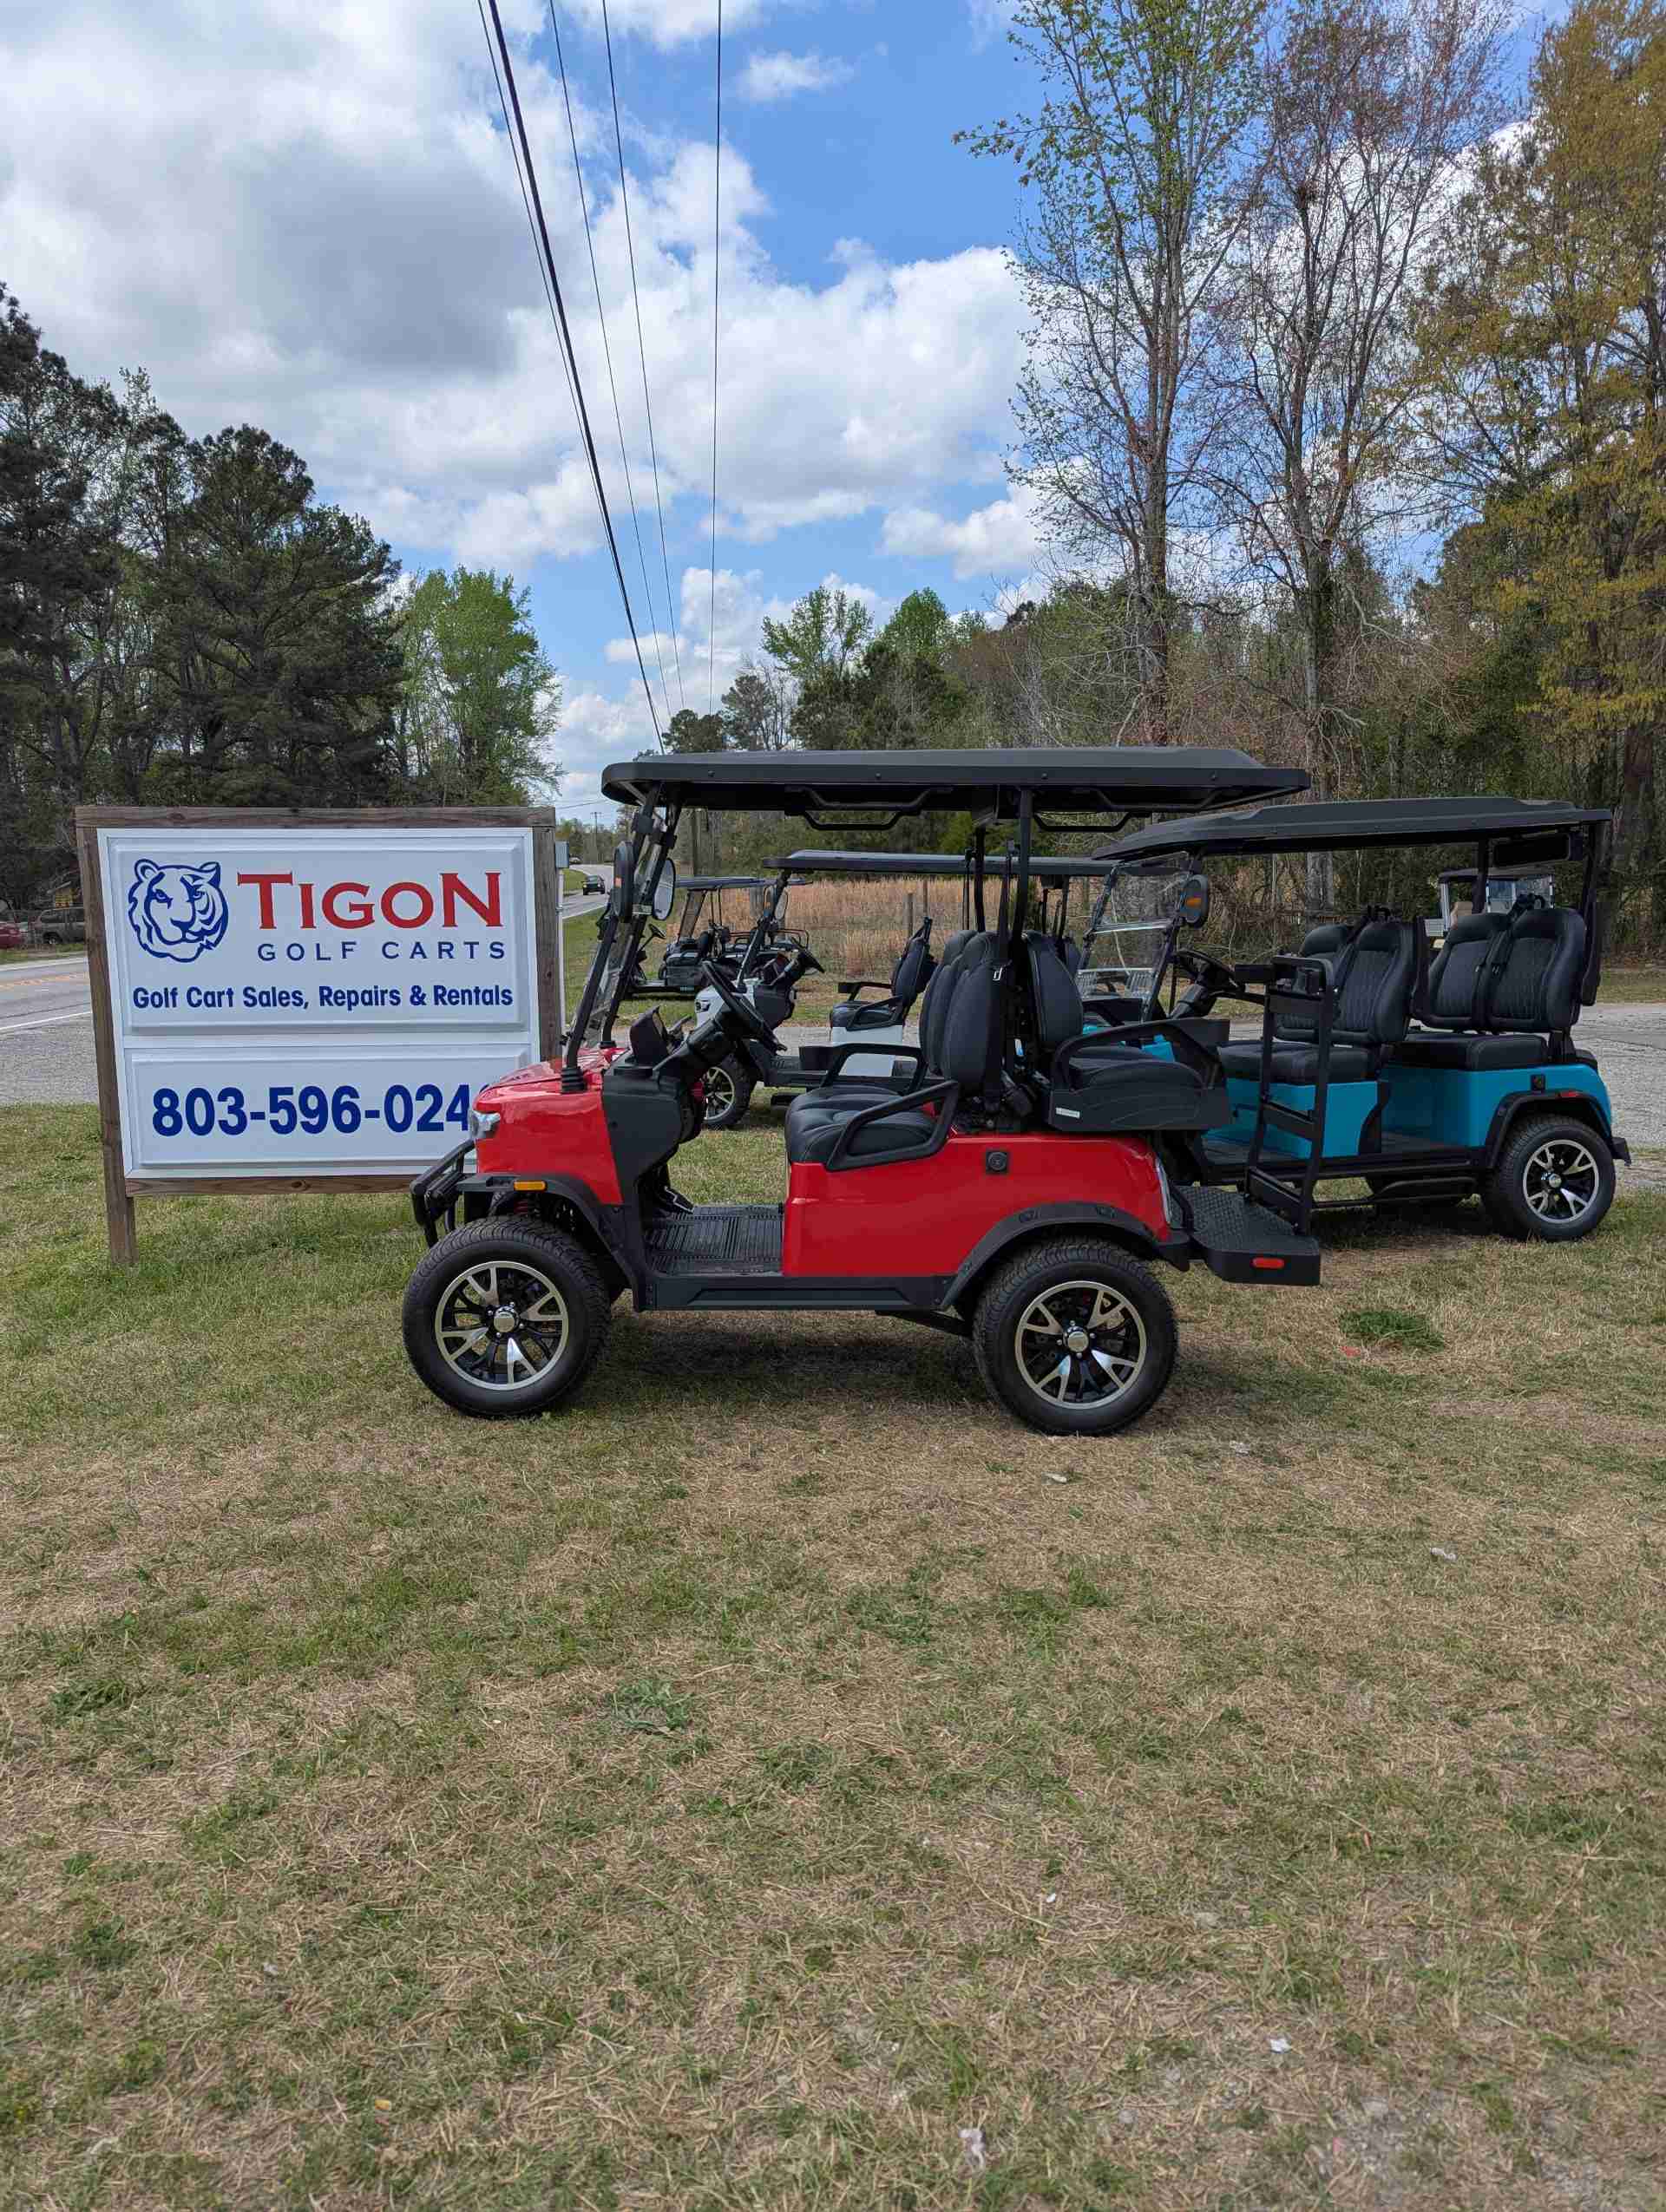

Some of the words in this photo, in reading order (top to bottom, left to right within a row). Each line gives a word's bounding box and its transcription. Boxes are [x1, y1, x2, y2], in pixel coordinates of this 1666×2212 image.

[238, 872, 502, 930] TIGON
[257, 941, 357, 962] GOLF
[381, 940, 506, 960] CARTS
[132, 986, 180, 1010] Golf
[186, 985, 235, 1009] Cart
[242, 985, 310, 1010] Sales,
[318, 985, 402, 1012] Repairs
[409, 985, 428, 1006] &
[433, 985, 514, 1006] Rentals
[152, 1083, 489, 1136] 803-596-024
